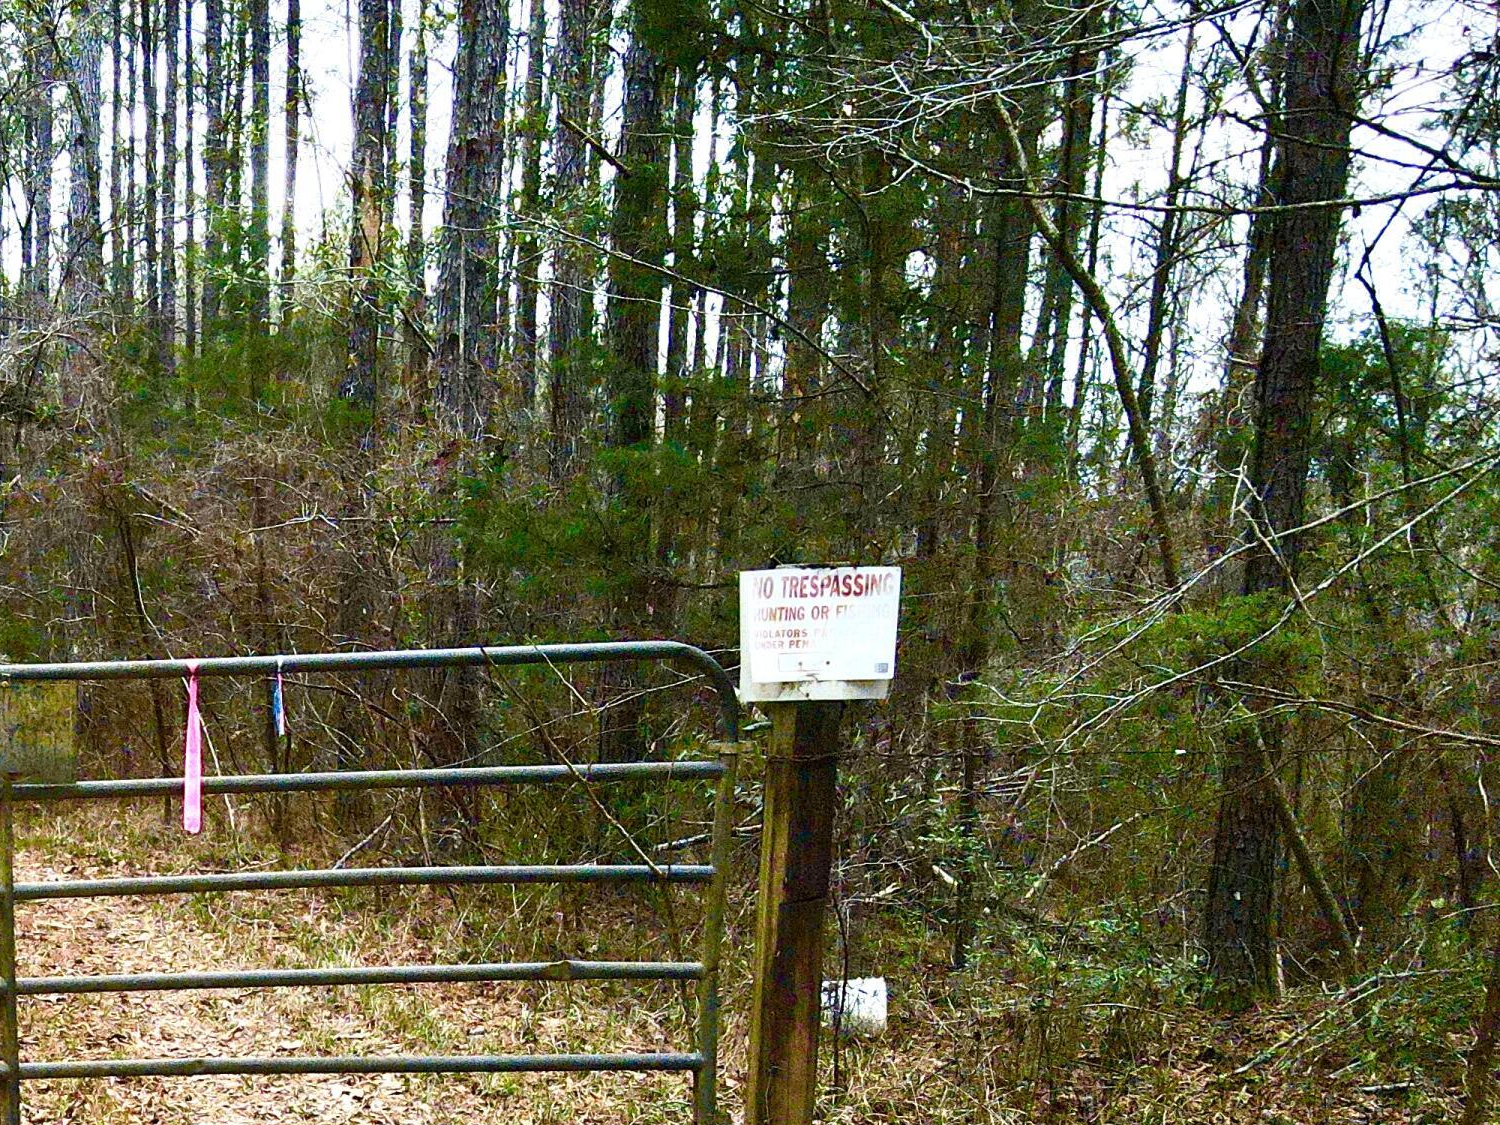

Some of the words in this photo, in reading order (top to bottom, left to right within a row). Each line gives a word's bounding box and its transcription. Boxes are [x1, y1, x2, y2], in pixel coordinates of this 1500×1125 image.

[753, 575, 774, 599] NO
[781, 572, 895, 599] TRESPASSING
[754, 605, 806, 622] HUNTING
[811, 604, 830, 621] OR
[755, 628, 808, 639] VIOLATORS
